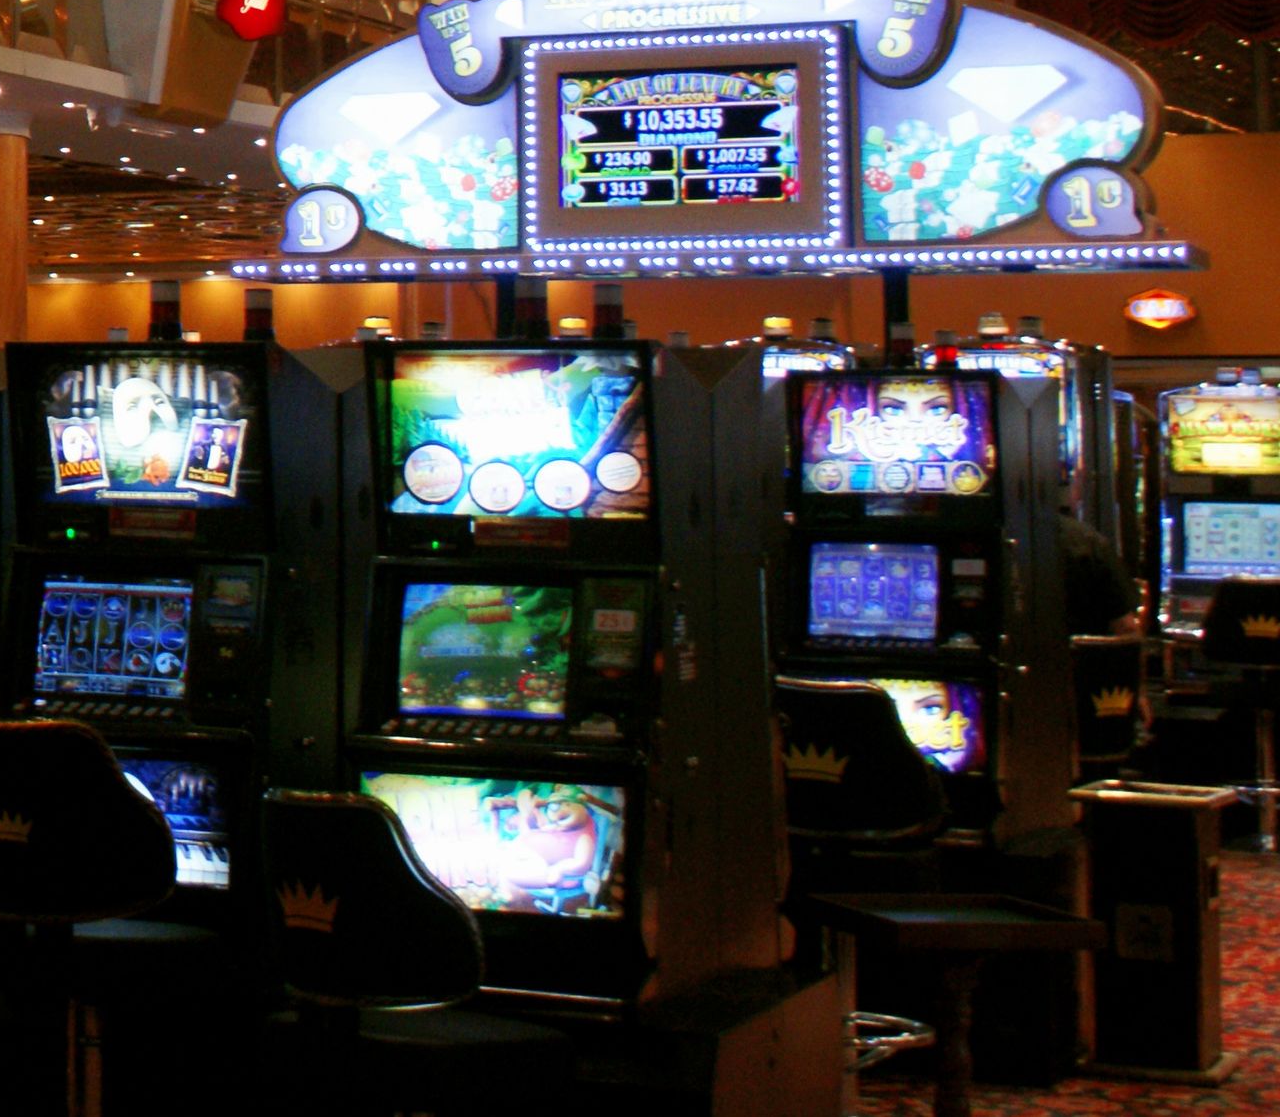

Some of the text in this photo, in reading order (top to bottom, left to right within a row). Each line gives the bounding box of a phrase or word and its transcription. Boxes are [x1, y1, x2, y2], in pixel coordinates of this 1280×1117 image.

[601, 4, 741, 30] PROGRESSIVE
[877, 17, 915, 58] 5
[449, 32, 483, 77] 5
[624, 108, 724, 132] $ 10,353.55
[638, 132, 719, 147] DIAMOND
